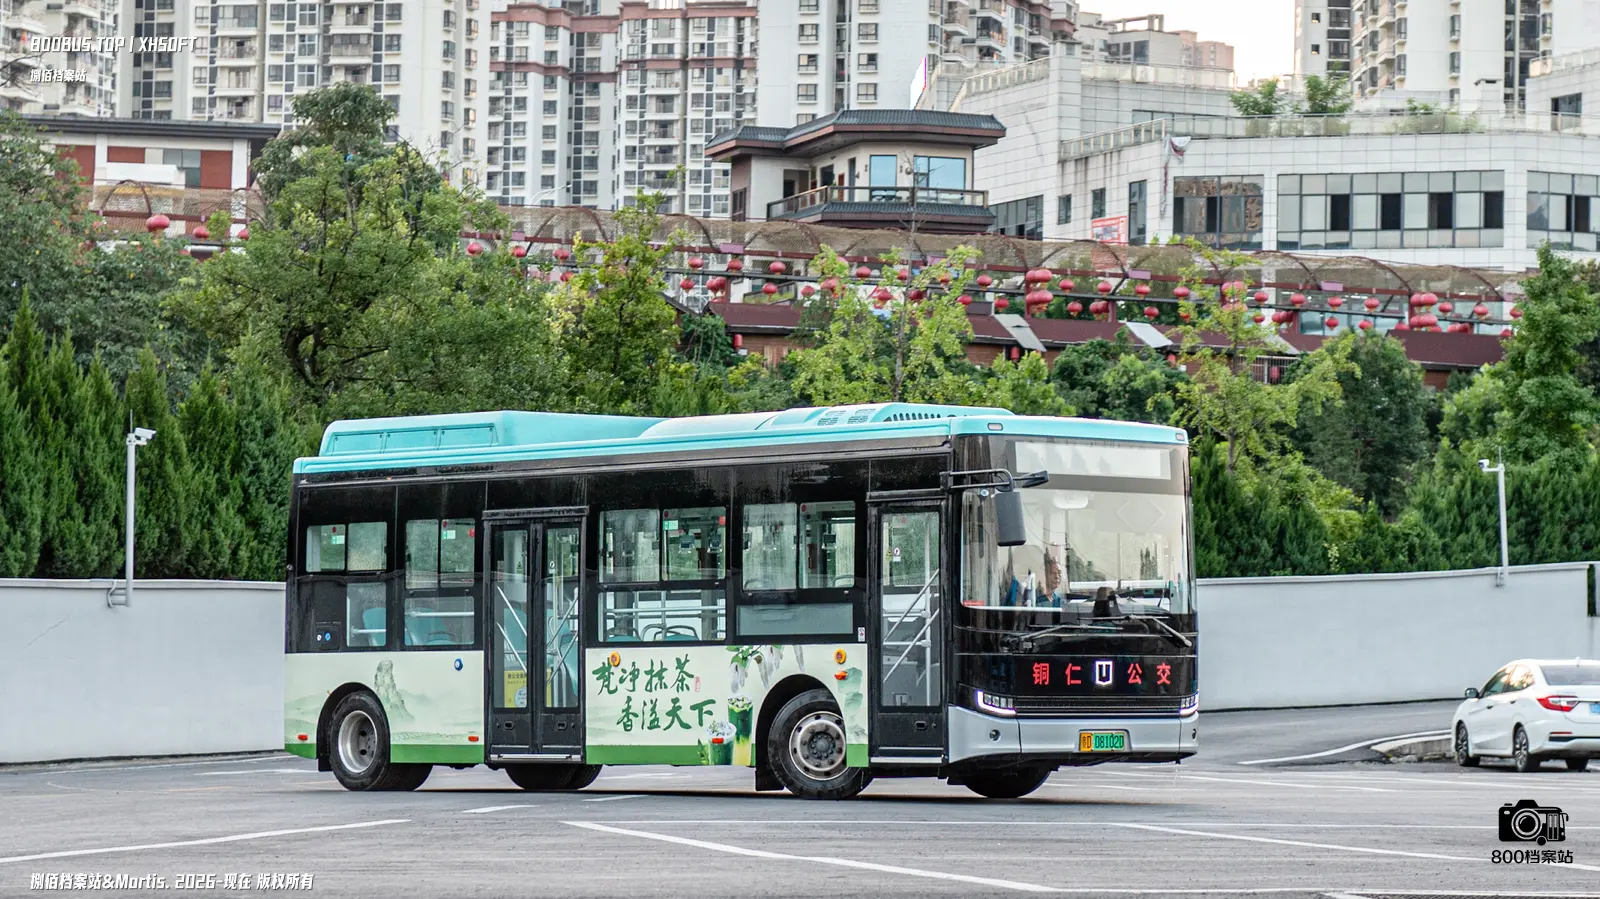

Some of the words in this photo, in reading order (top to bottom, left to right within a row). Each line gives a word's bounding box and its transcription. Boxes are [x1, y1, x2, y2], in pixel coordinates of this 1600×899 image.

[592, 653, 695, 696] 梵净抹茶
[1032, 662, 1082, 686] 铜仁
[1127, 662, 1172, 686] 公交
[616, 695, 717, 732] 香溢天下
